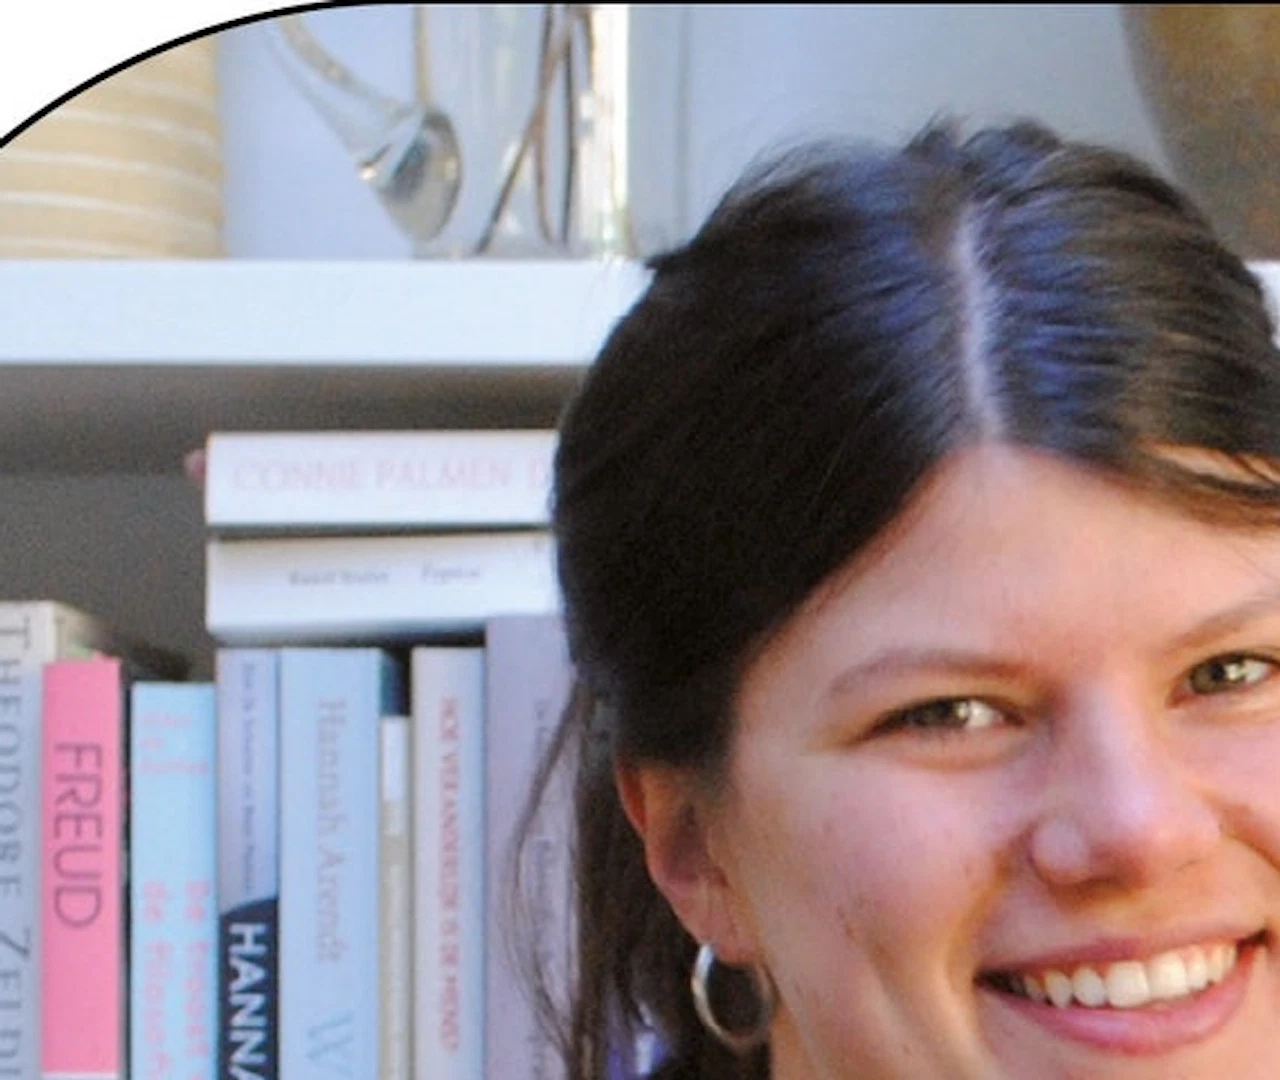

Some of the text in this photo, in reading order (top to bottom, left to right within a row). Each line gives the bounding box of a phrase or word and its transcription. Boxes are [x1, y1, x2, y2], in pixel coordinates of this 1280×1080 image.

[231, 458, 360, 491] CONNIE
[376, 457, 514, 490] PALMEN
[0, 616, 32, 898] THEODORE
[53, 742, 101, 930] FREUD
[315, 698, 350, 967] Hannah Arendt
